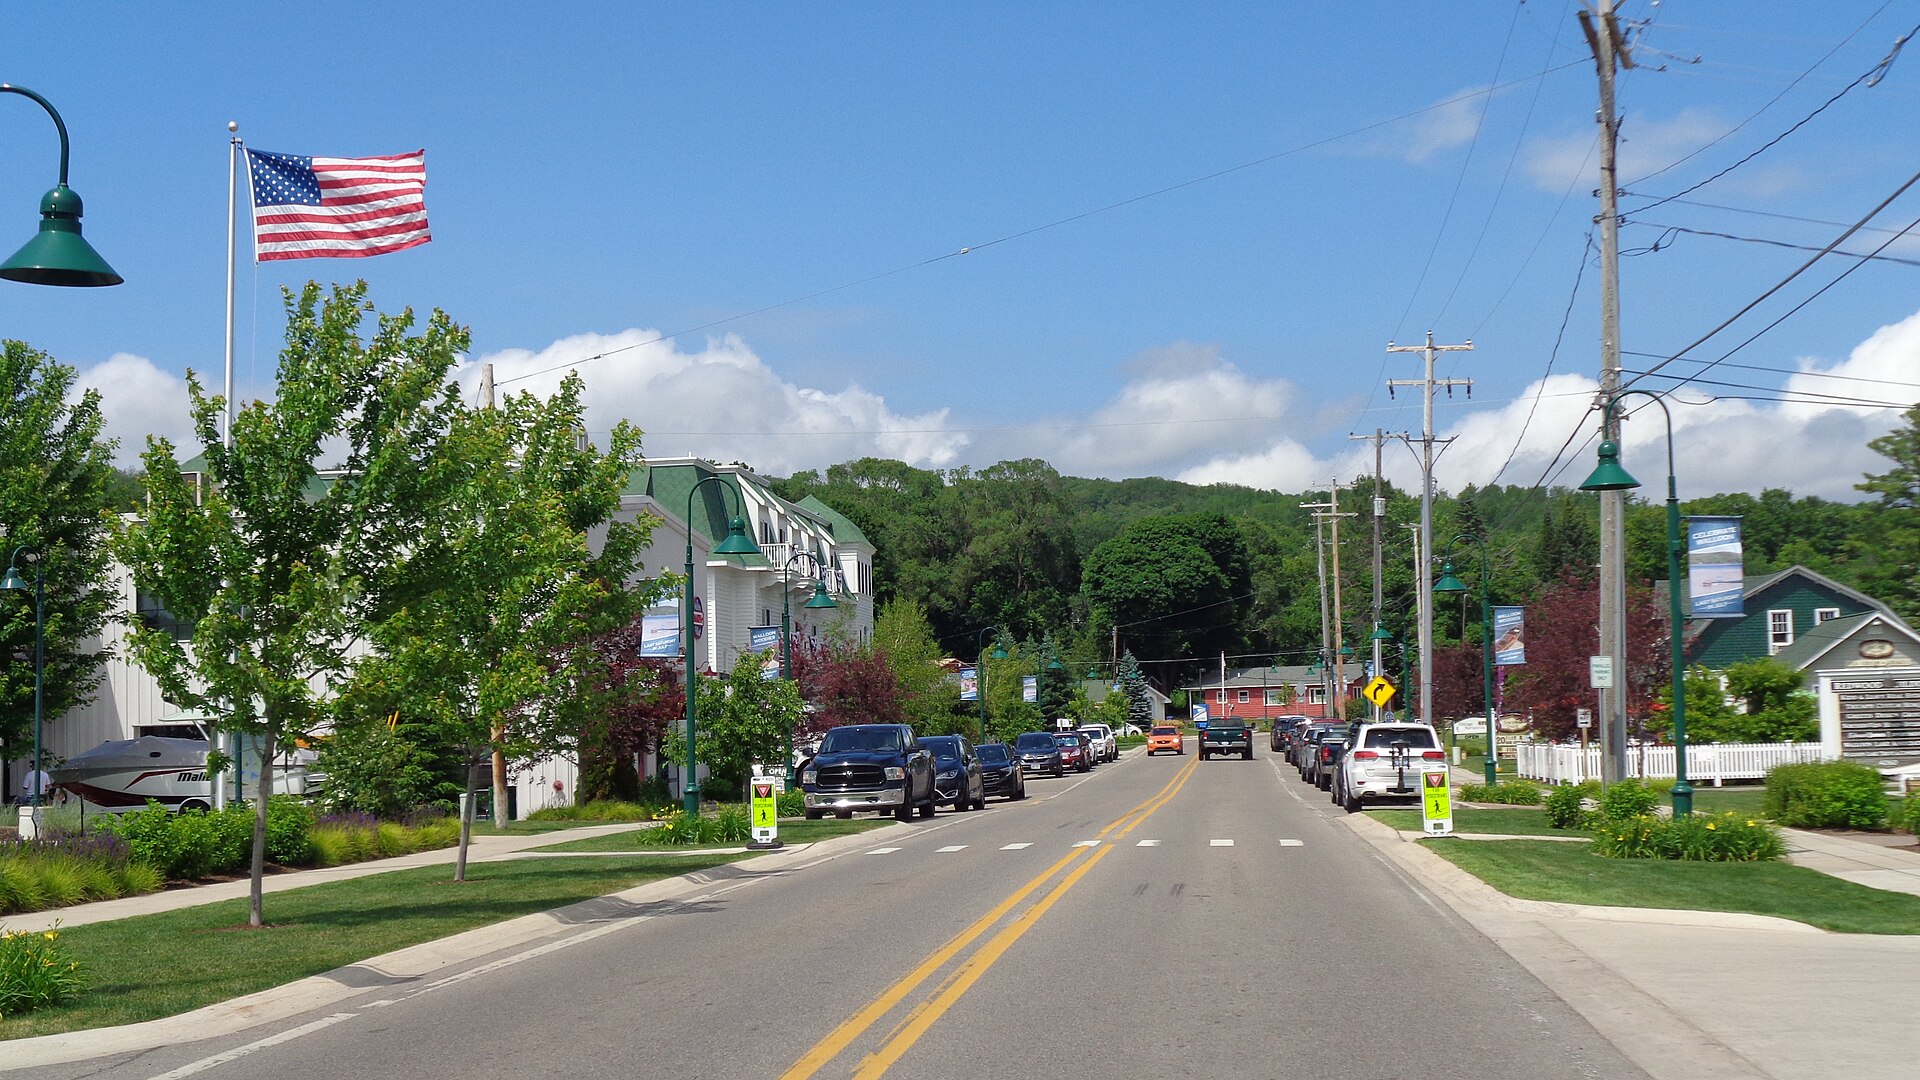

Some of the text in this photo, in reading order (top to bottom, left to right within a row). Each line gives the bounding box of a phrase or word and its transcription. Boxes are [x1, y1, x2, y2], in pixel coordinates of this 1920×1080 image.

[1692, 527, 1737, 540] CELEBRATE
[1695, 534, 1735, 545] WALLOON
[753, 631, 776, 639] WALLOON
[754, 635, 776, 643] WOODIES
[768, 768, 787, 777] OPEN
